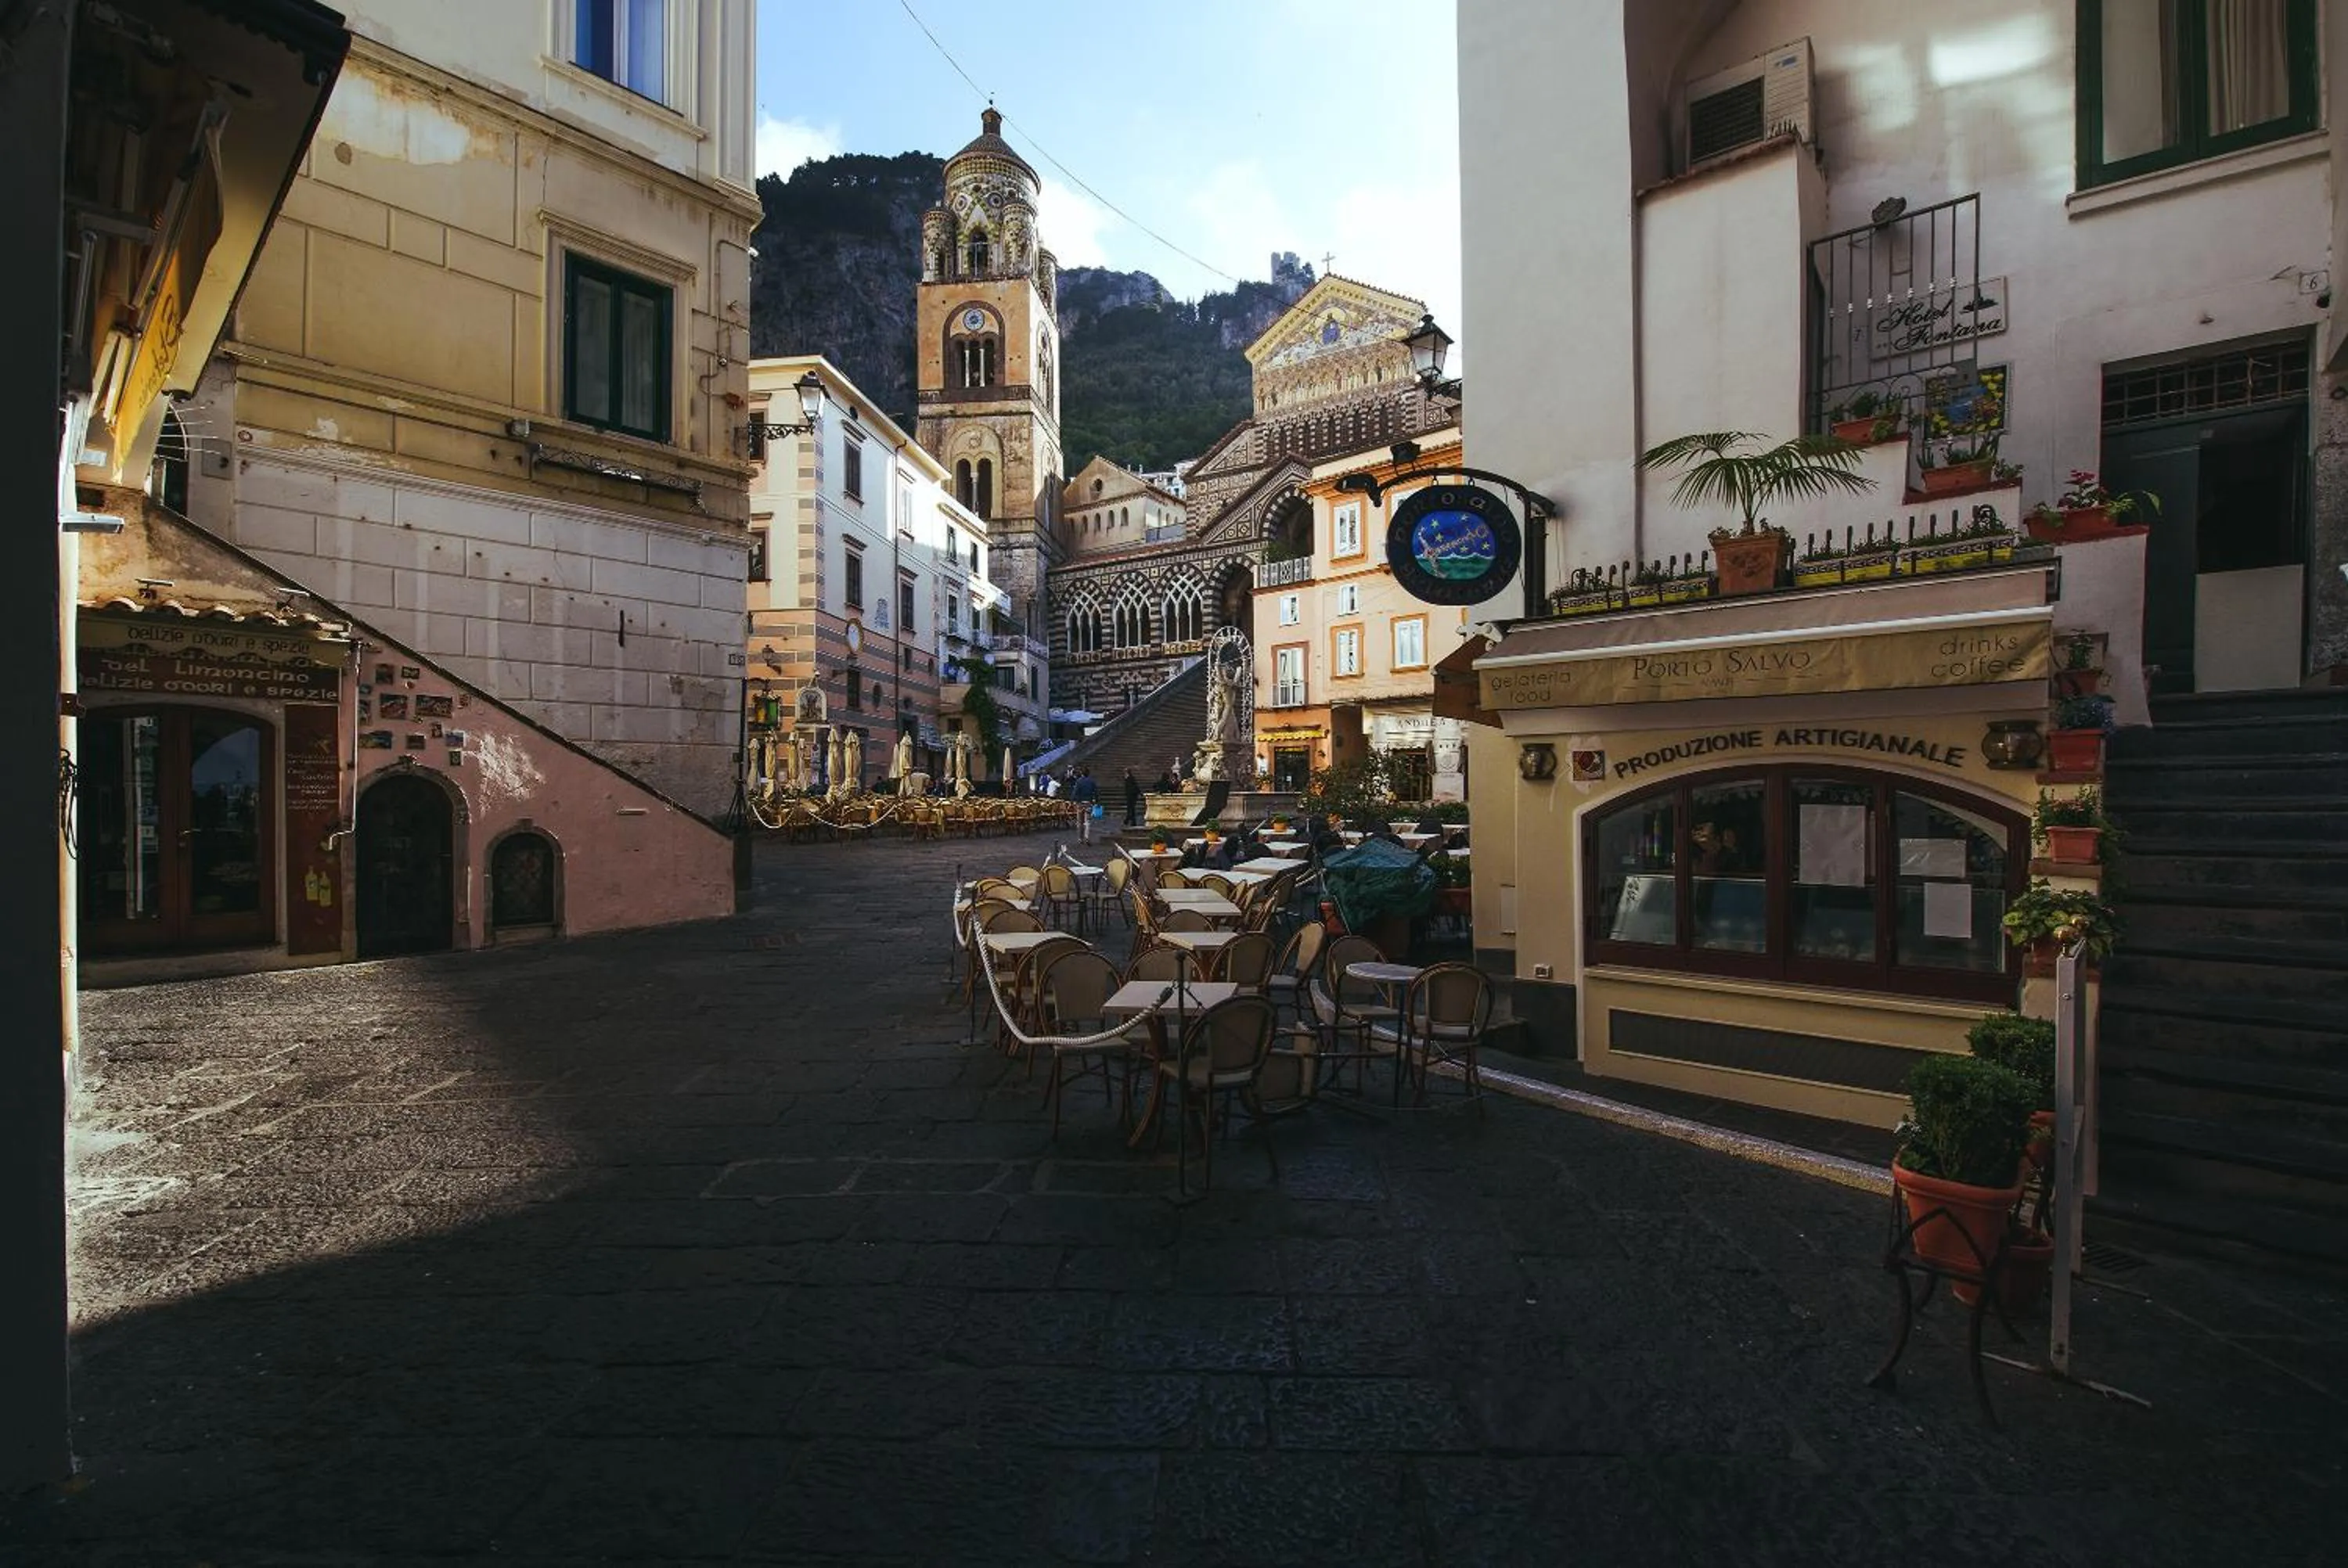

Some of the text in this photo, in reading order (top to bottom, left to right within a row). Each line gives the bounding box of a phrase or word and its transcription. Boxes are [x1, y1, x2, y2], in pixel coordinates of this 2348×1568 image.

[1876, 299, 1953, 332] Hotel
[1894, 318, 2001, 350] Fontana
[1940, 634, 2018, 656] drinks
[1930, 656, 2024, 678] coffee
[1491, 671, 1571, 691] gelateria
[1510, 686, 1551, 703] food
[1613, 728, 1967, 779] PRODUZIONE ARTIGIANALE
